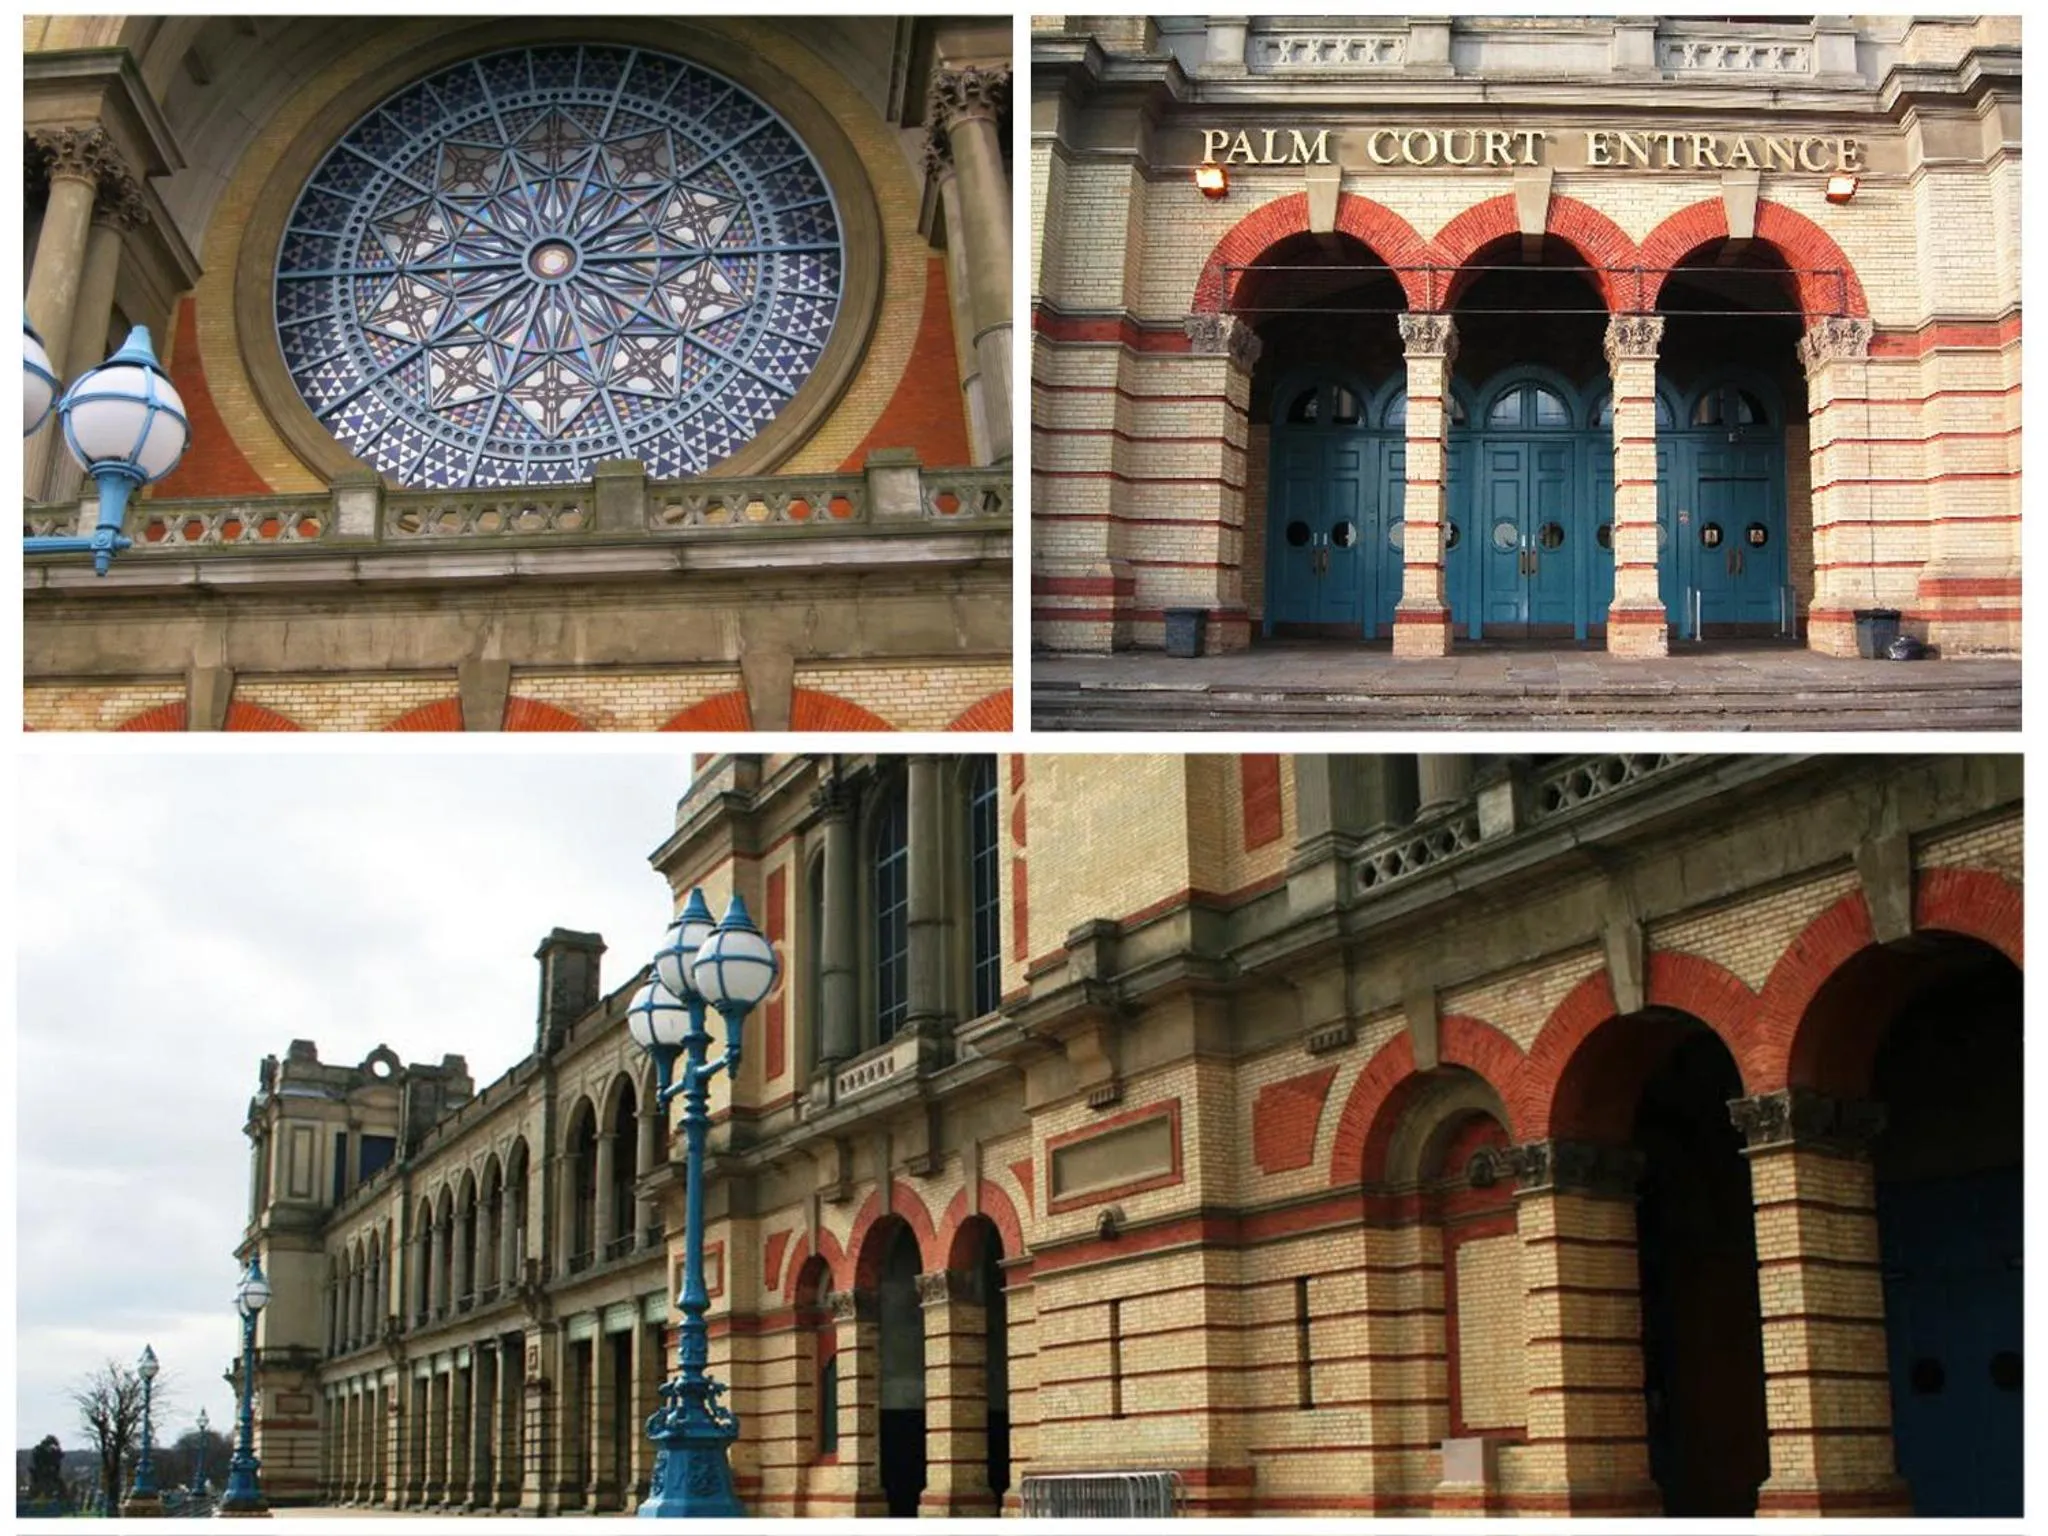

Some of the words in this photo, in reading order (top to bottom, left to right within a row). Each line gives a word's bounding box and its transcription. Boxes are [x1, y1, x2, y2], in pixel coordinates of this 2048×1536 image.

[1201, 128, 1332, 165] PALM
[1367, 127, 1546, 165] COURT
[1585, 131, 1862, 171] ENTRANCE
